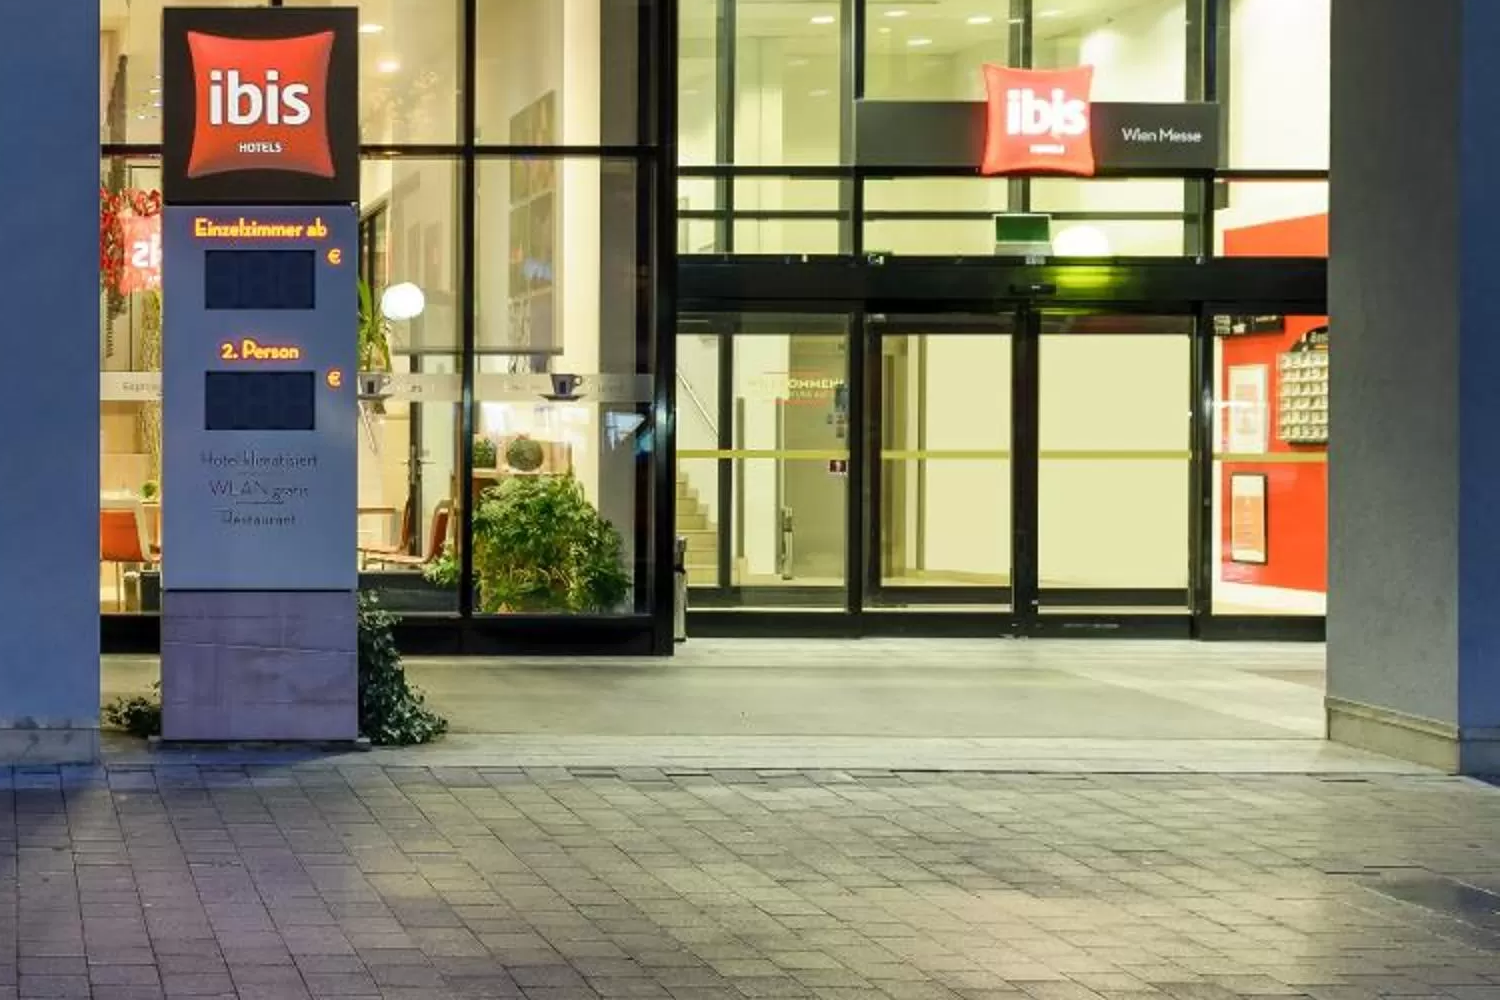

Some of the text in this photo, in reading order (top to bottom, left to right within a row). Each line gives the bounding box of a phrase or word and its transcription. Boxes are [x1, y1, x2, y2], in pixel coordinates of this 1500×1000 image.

[210, 69, 311, 125] ibis
[1006, 88, 1088, 136] ibis
[1121, 127, 1202, 144] Wien Messe
[238, 142, 283, 153] HOTELS
[194, 217, 328, 237] Einzelzimmer ab
[327, 248, 342, 265] €
[221, 339, 300, 359] 2. Person
[327, 371, 342, 387] €
